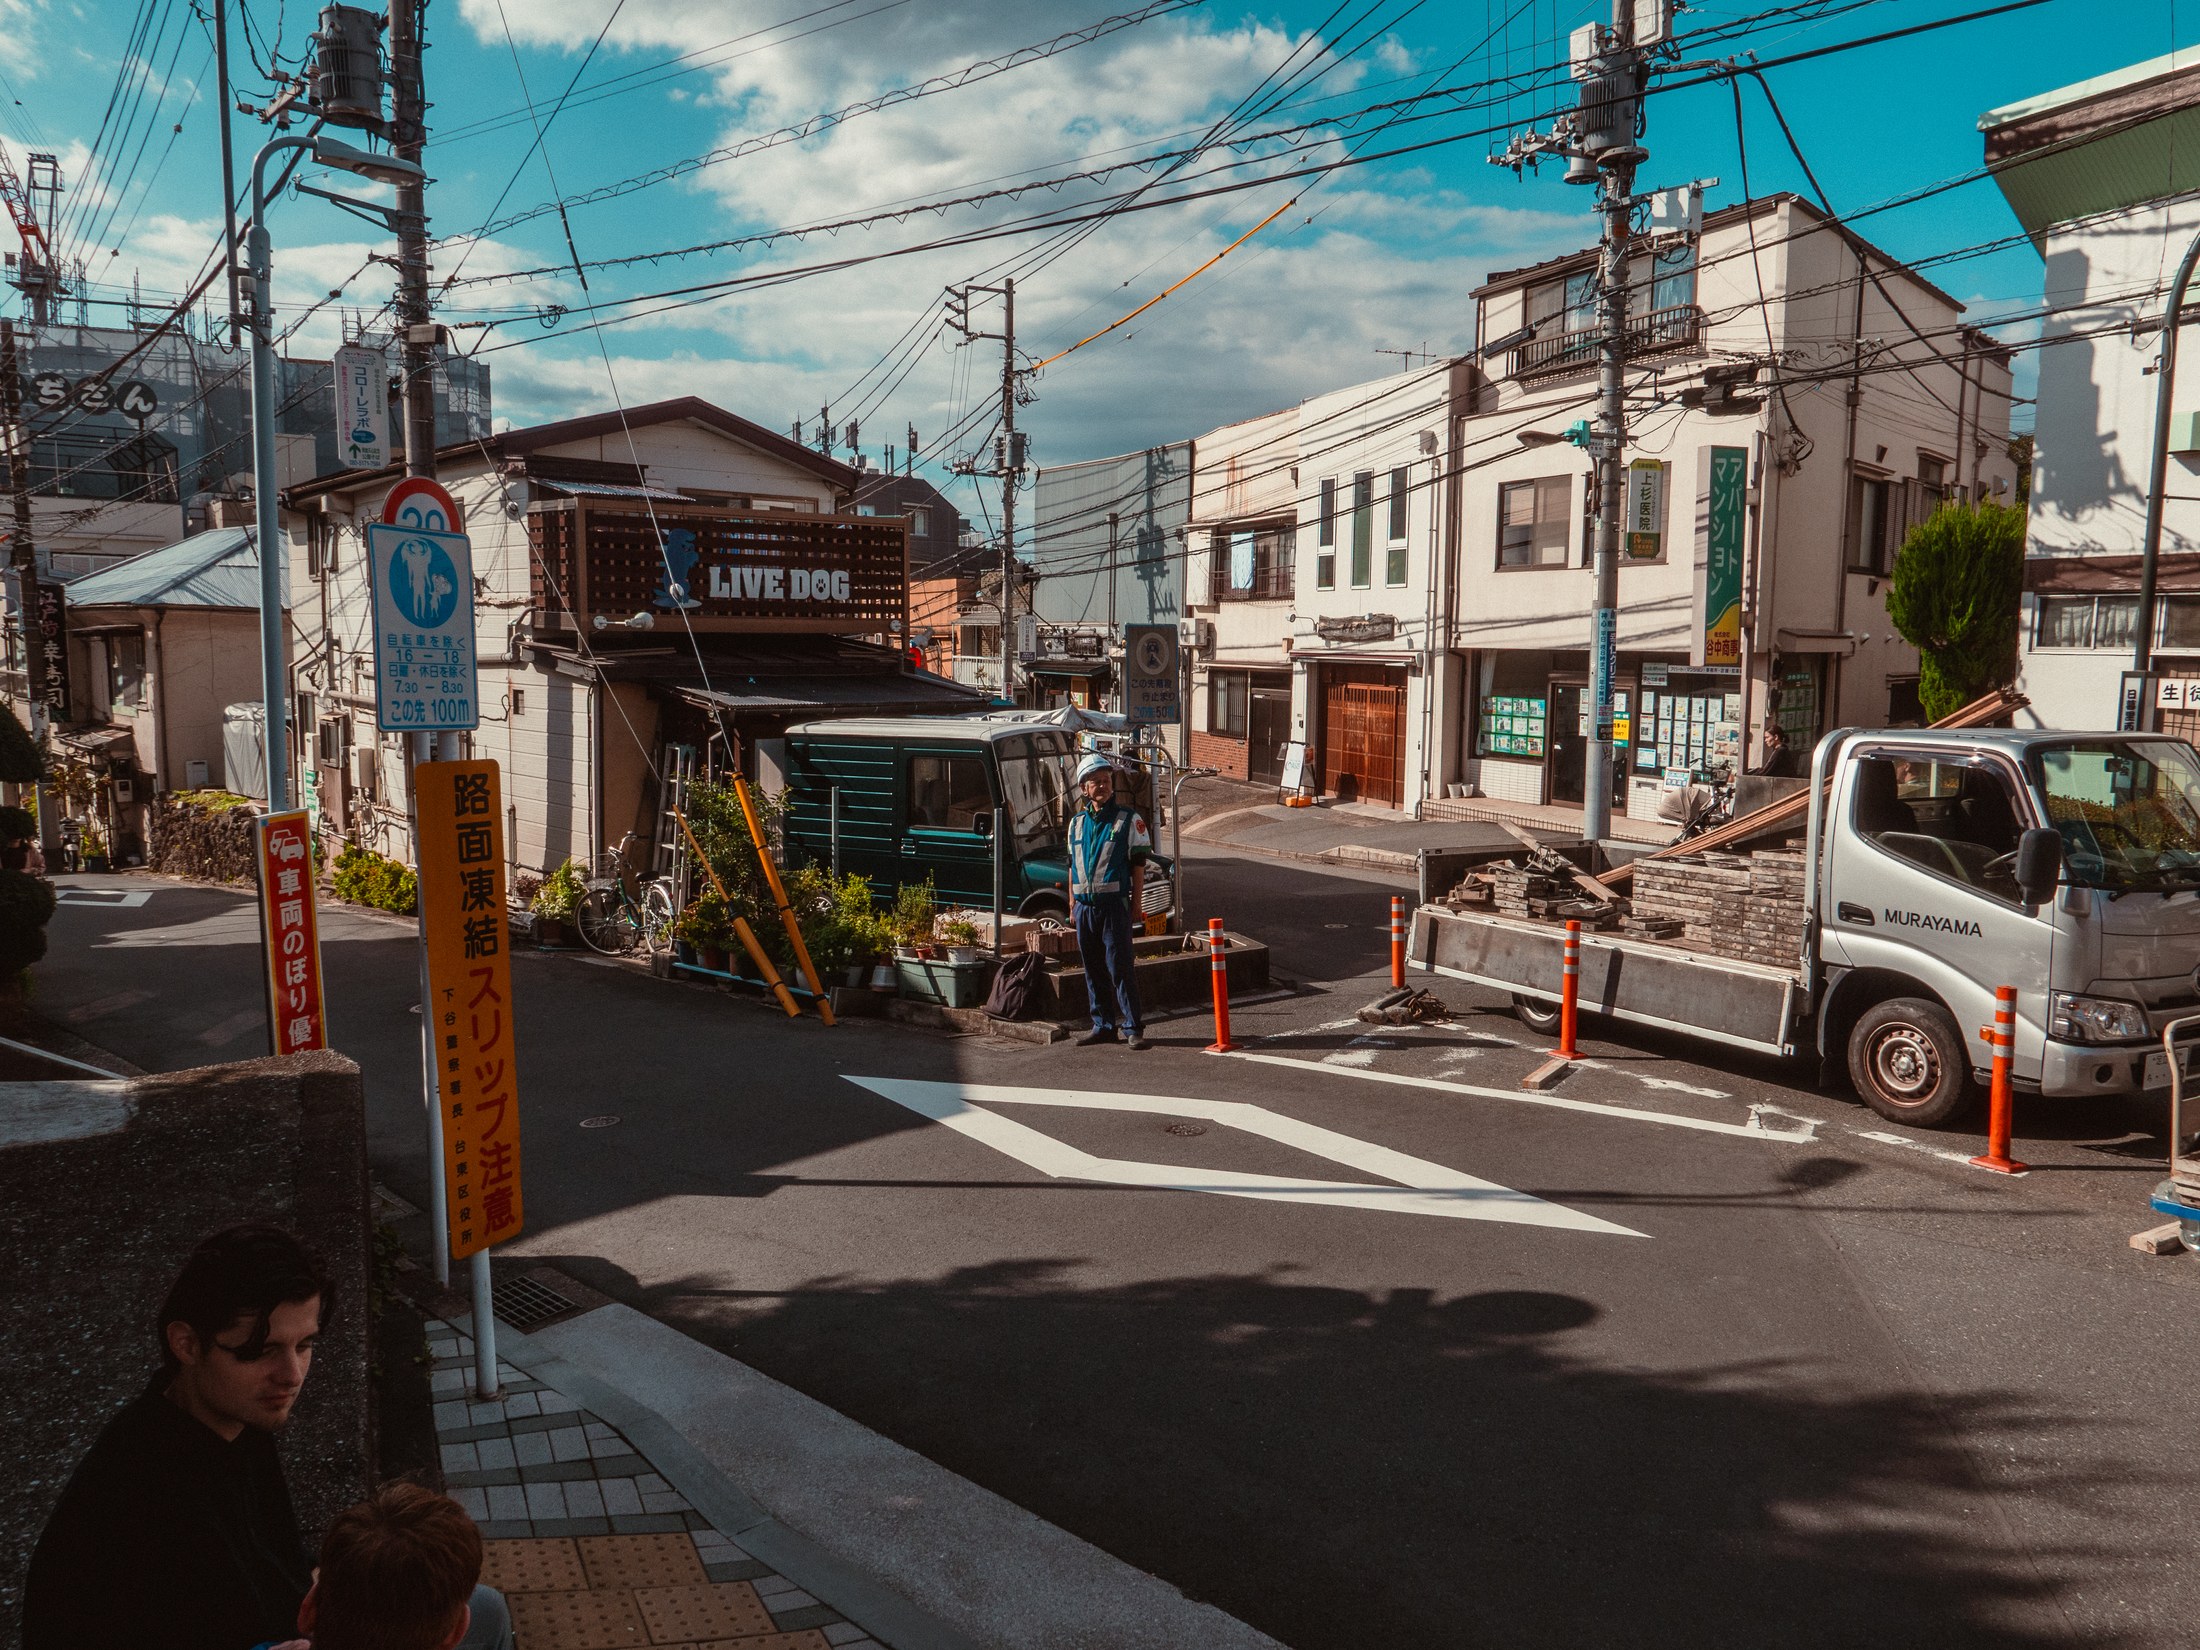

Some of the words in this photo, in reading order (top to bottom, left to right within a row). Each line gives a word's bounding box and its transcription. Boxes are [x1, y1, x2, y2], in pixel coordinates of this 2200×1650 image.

[355, 366, 371, 428] コローレラボ
[1639, 472, 1652, 530] 上杉医院
[1728, 458, 1743, 575] アパート
[1711, 458, 1727, 596] マンション
[709, 566, 784, 598] LIVE
[790, 569, 850, 600] DOG
[388, 634, 466, 649] 自転車を除く
[397, 650, 413, 662] 16
[443, 651, 459, 664] 18
[1706, 638, 1739, 658] 谷中商事
[389, 665, 467, 679] 日曜・休日を除く
[391, 700, 425, 722] この先
[431, 700, 470, 722] 100m
[1885, 908, 1982, 938] MURAYAMA
[277, 868, 312, 1055] 車両のぼり優
[442, 987, 473, 1245] 下谷警察署長・台東区役所
